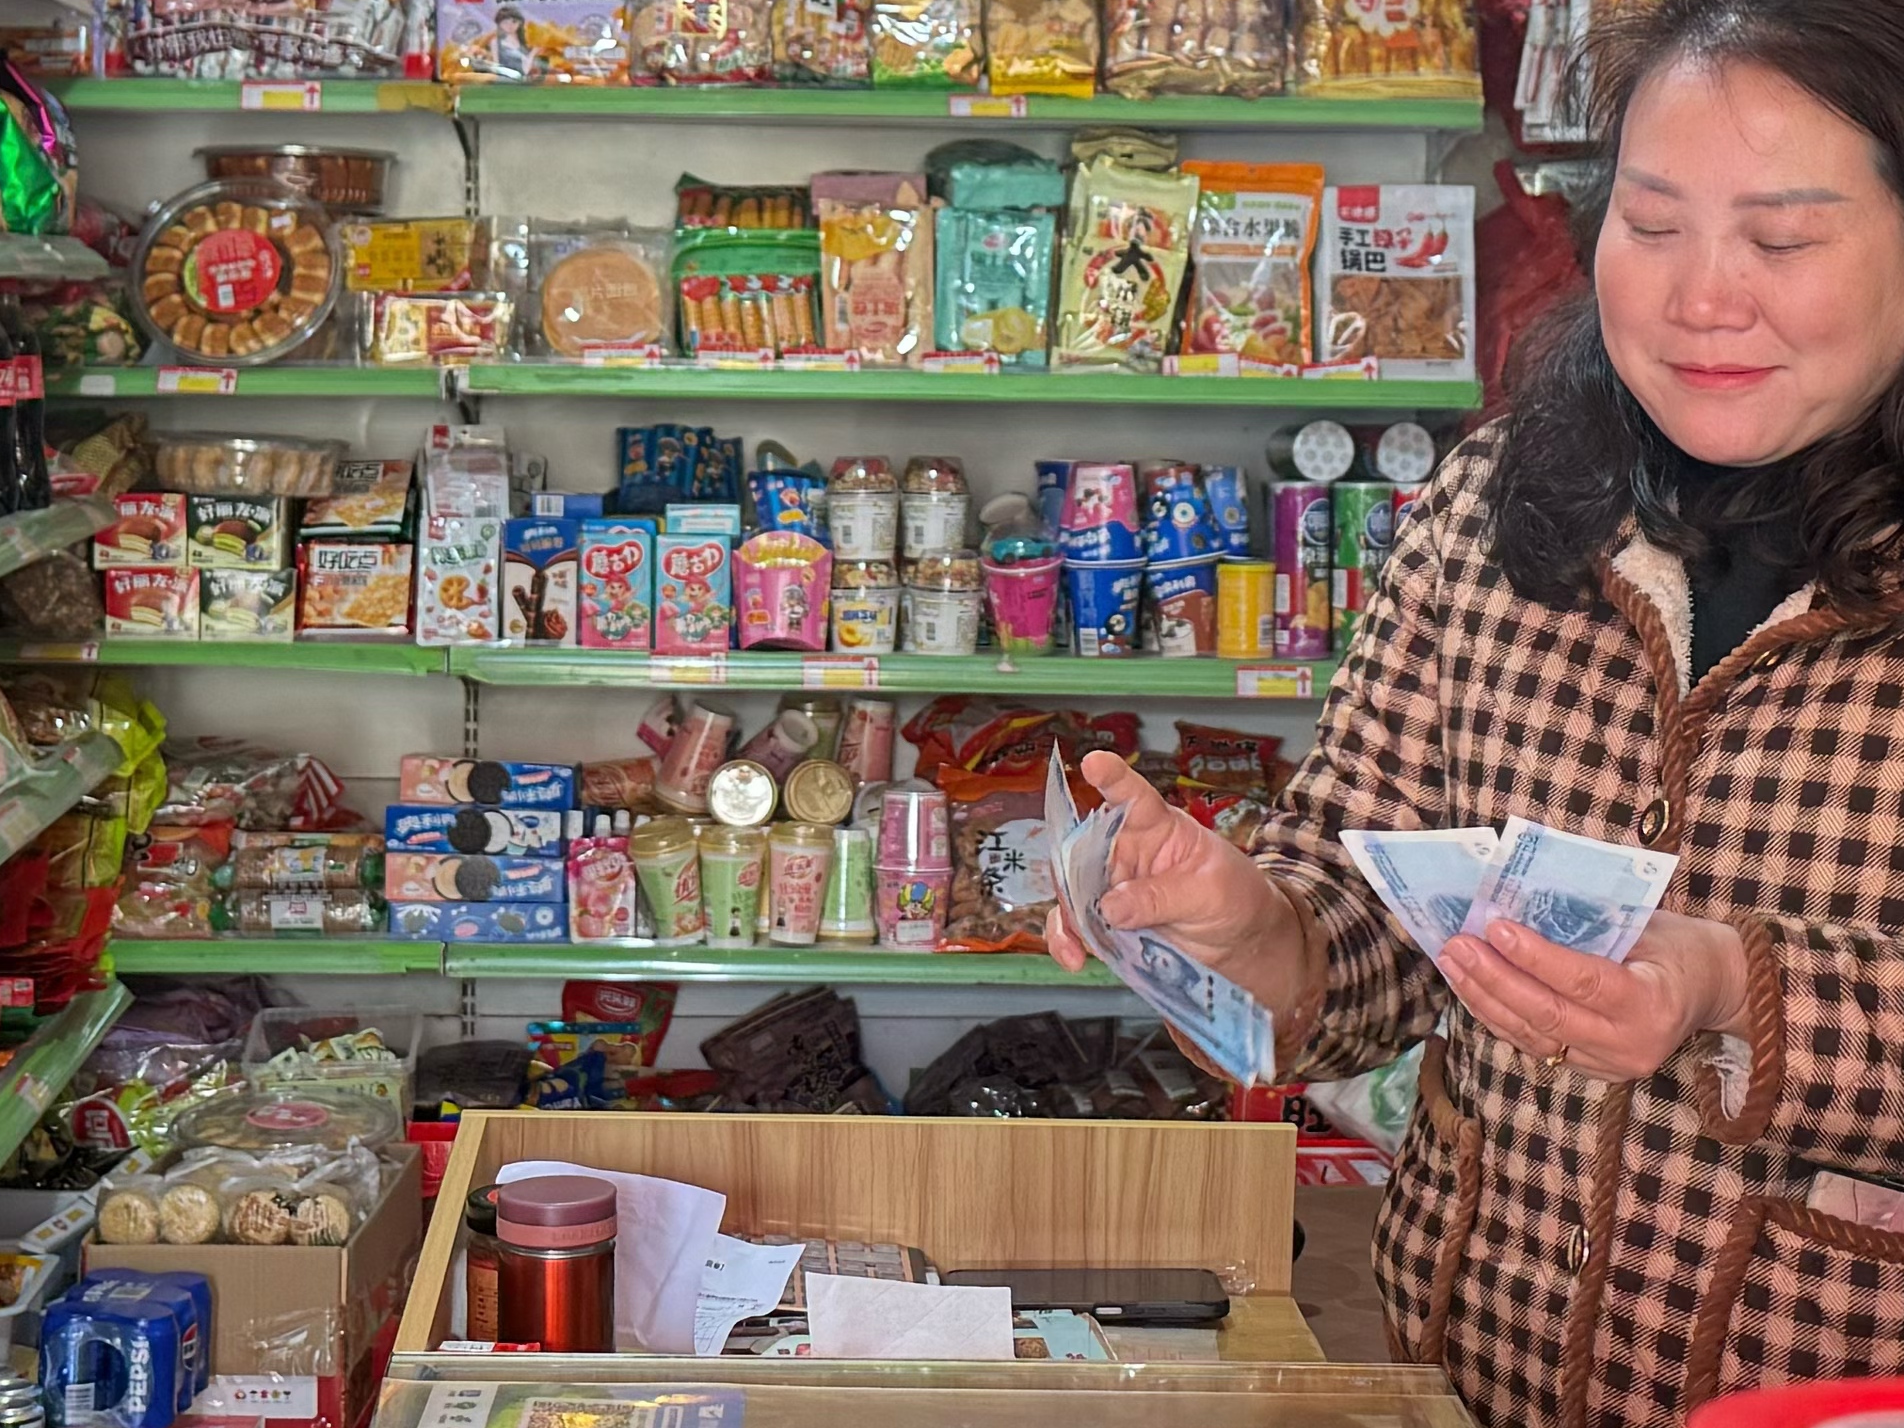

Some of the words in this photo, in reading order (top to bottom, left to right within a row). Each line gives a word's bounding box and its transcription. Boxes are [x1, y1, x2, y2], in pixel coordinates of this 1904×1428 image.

[318, 550, 379, 571] 好吃点
[126, 1335, 149, 1414] PEPSI
